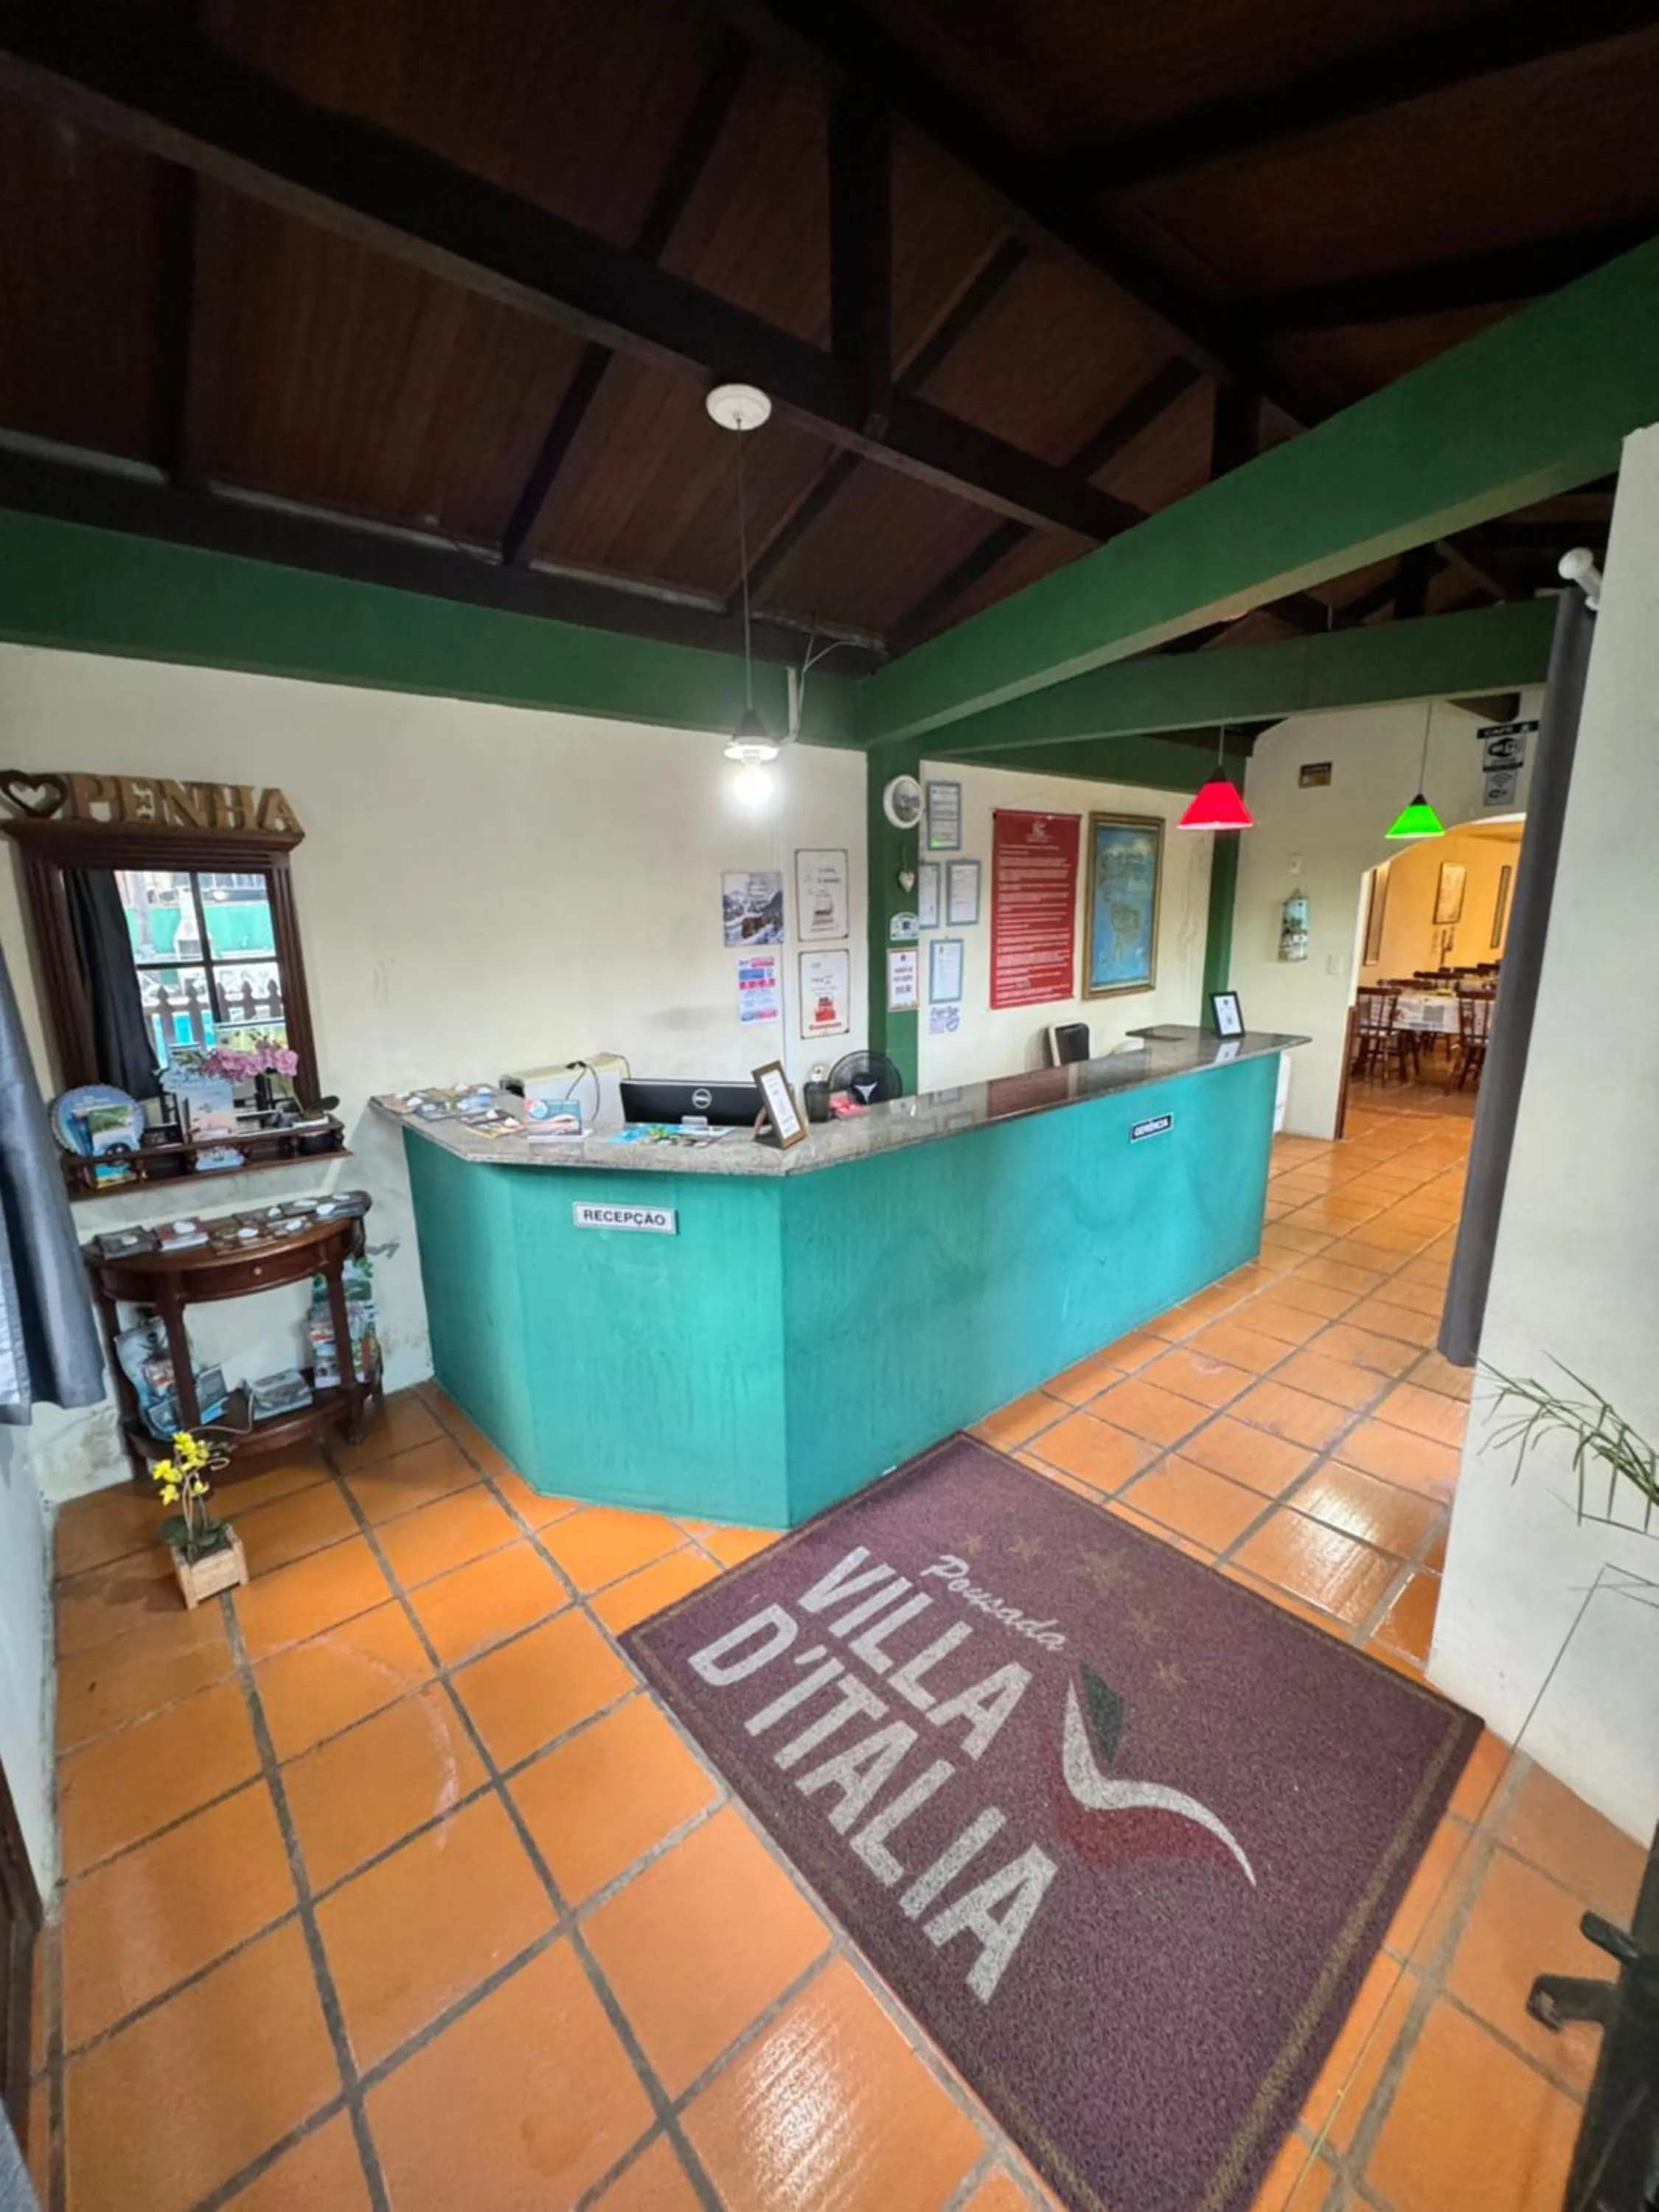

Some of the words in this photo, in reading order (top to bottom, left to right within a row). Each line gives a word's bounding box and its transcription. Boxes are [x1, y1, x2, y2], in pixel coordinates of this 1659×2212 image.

[72, 773, 303, 833] PENHA
[798, 1545, 1033, 1761] VILLA
[921, 1555, 1067, 1652] Pousada
[687, 1602, 1059, 2006] D'ITALIA
